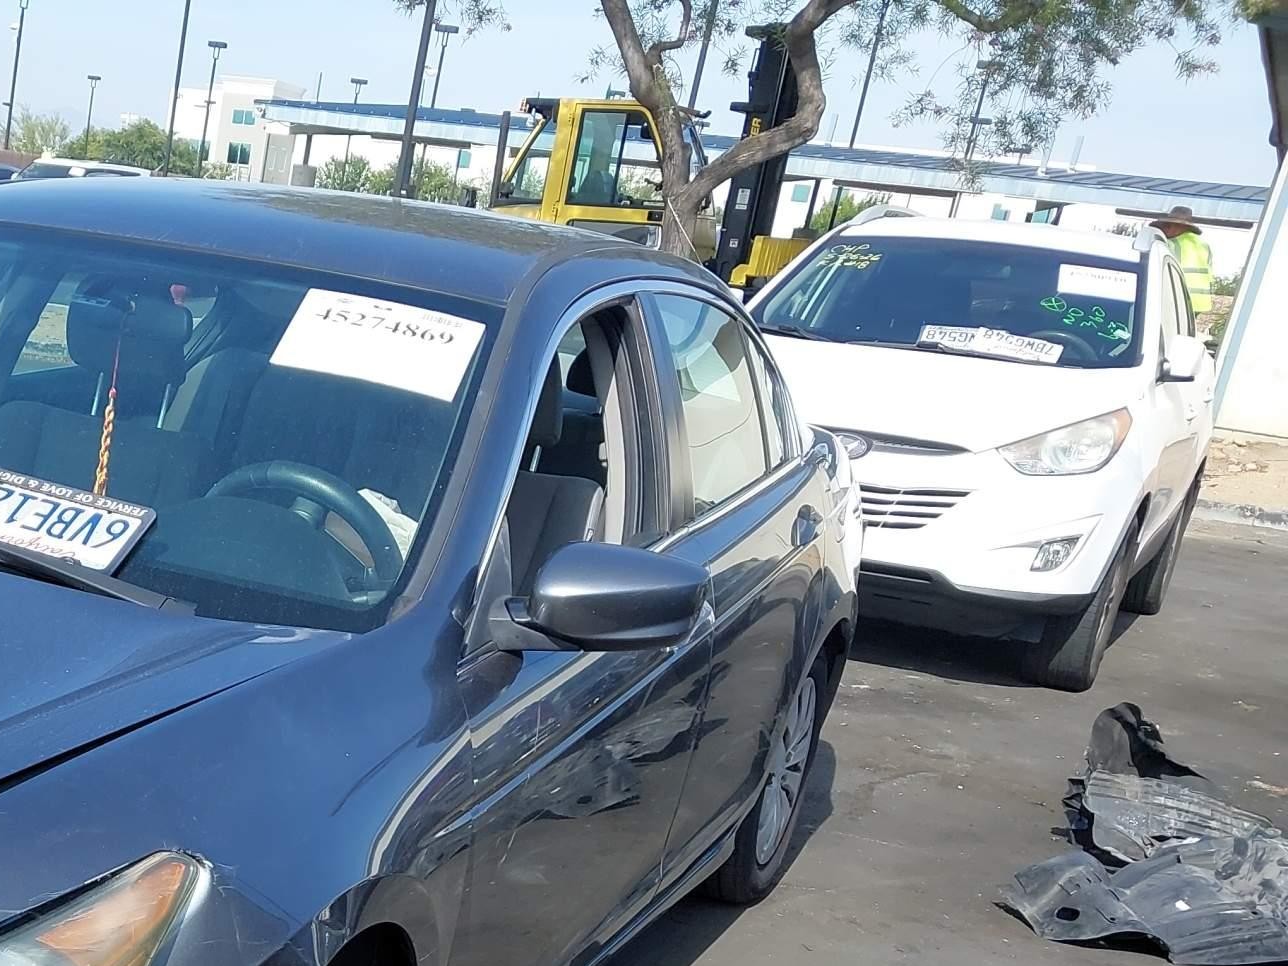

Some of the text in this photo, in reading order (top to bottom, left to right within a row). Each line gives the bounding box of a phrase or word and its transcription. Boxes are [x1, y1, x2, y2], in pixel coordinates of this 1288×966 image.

[831, 244, 870, 253] CHP
[315, 307, 455, 344] 45274869
[26, 479, 39, 488] &
[40, 483, 73, 499] LOVE
[73, 492, 93, 503] OF
[95, 497, 150, 518] SERVICE
